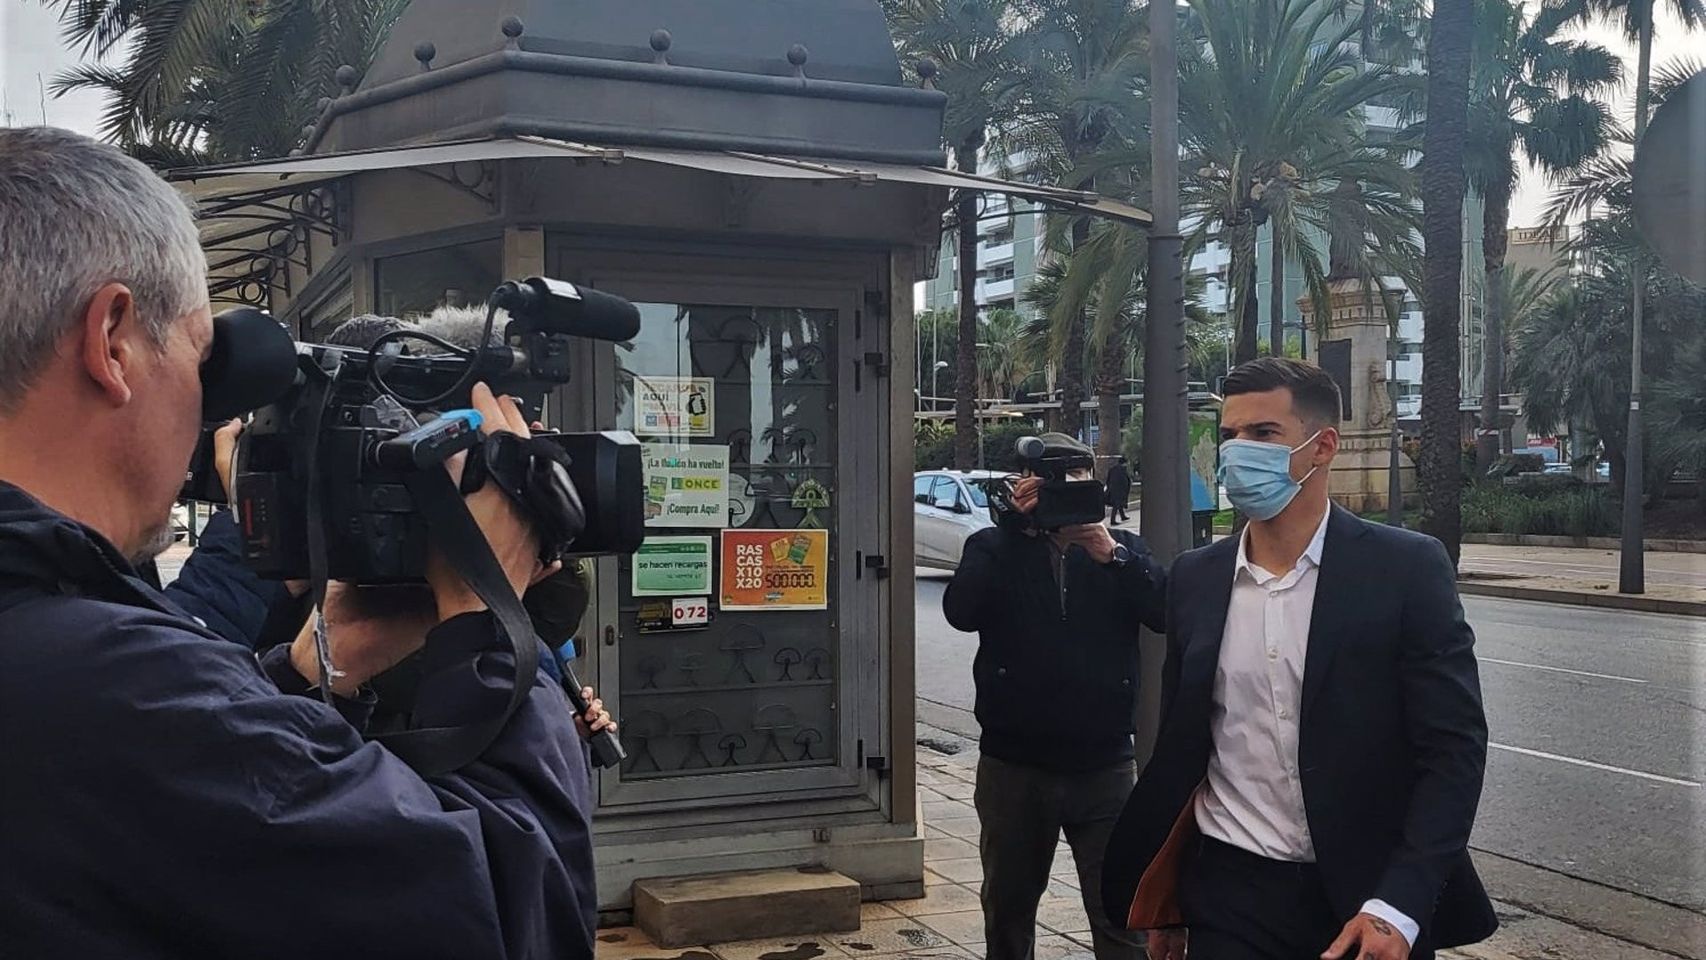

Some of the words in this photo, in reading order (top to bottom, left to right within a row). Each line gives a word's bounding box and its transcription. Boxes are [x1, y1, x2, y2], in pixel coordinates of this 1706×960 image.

[688, 458, 698, 469] ha
[699, 460, 725, 470] vuelto!
[685, 480, 719, 489] ONCE
[667, 503, 699, 516] ¡Compra
[736, 544, 764, 556] RAS
[650, 561, 673, 569] hacen
[674, 561, 708, 570] recargas
[736, 556, 764, 567] CAS
[736, 567, 763, 578] X10
[736, 578, 762, 589] X20
